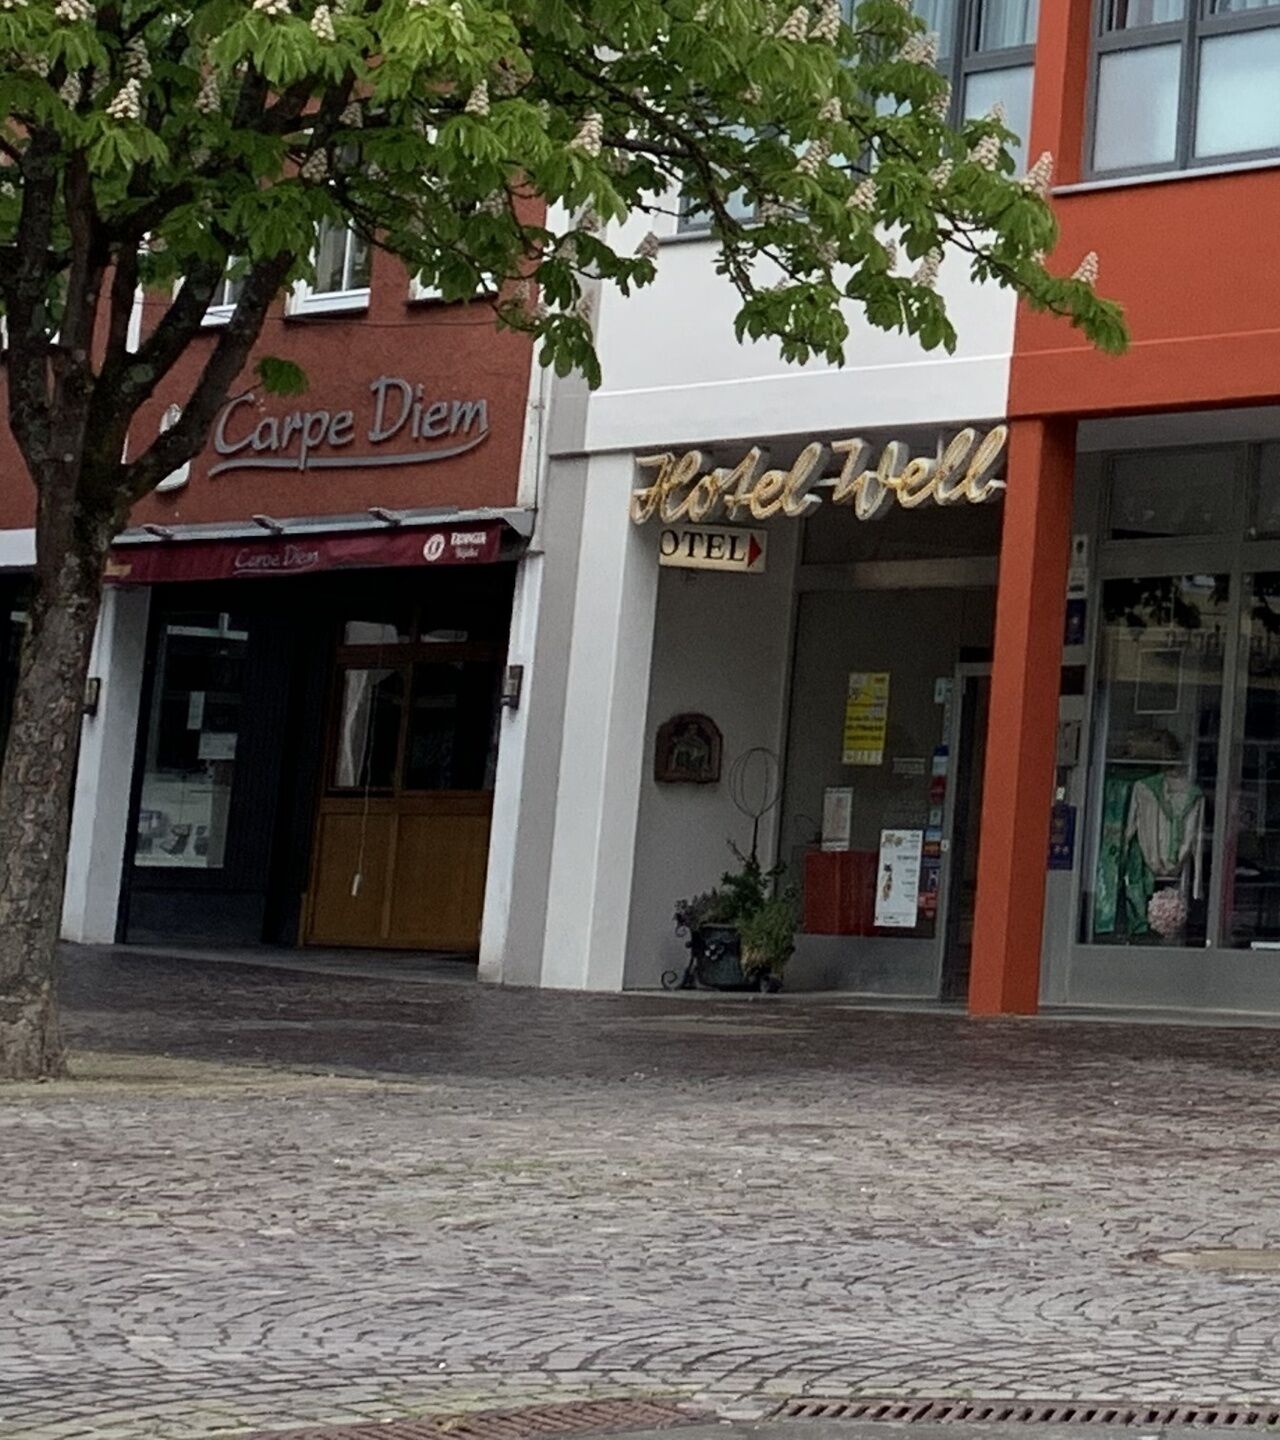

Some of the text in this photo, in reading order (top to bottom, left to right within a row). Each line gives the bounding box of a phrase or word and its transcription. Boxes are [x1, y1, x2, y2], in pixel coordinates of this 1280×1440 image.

[214, 376, 489, 470] Carpe Diem
[631, 424, 1007, 525] Hotel Well
[660, 529, 746, 563] OTEL
